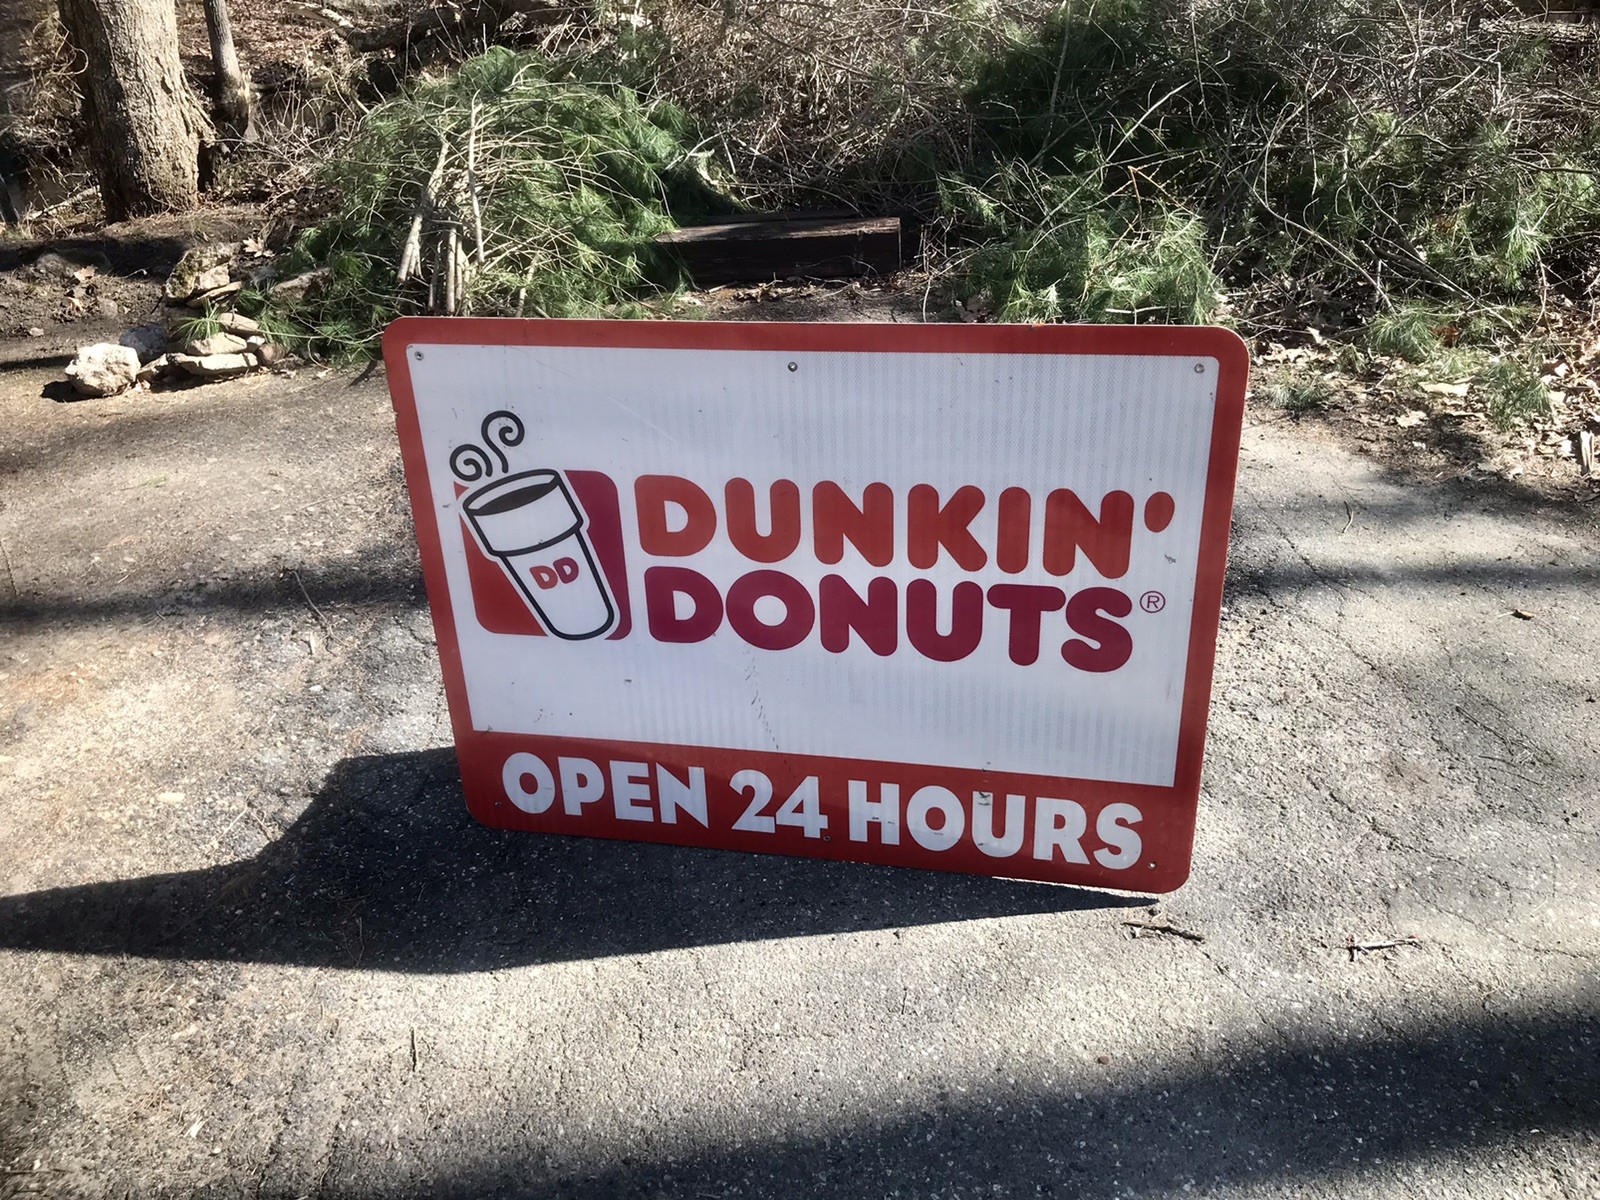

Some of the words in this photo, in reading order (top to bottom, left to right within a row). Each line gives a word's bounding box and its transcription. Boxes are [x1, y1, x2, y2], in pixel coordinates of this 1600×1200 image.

[529, 557, 578, 590] DD
[634, 474, 1175, 579] DUNKIN'
[643, 566, 1133, 672] DONUTS
[501, 752, 708, 828] OPEN
[730, 769, 829, 839] 24
[848, 780, 1143, 869] HOURS
